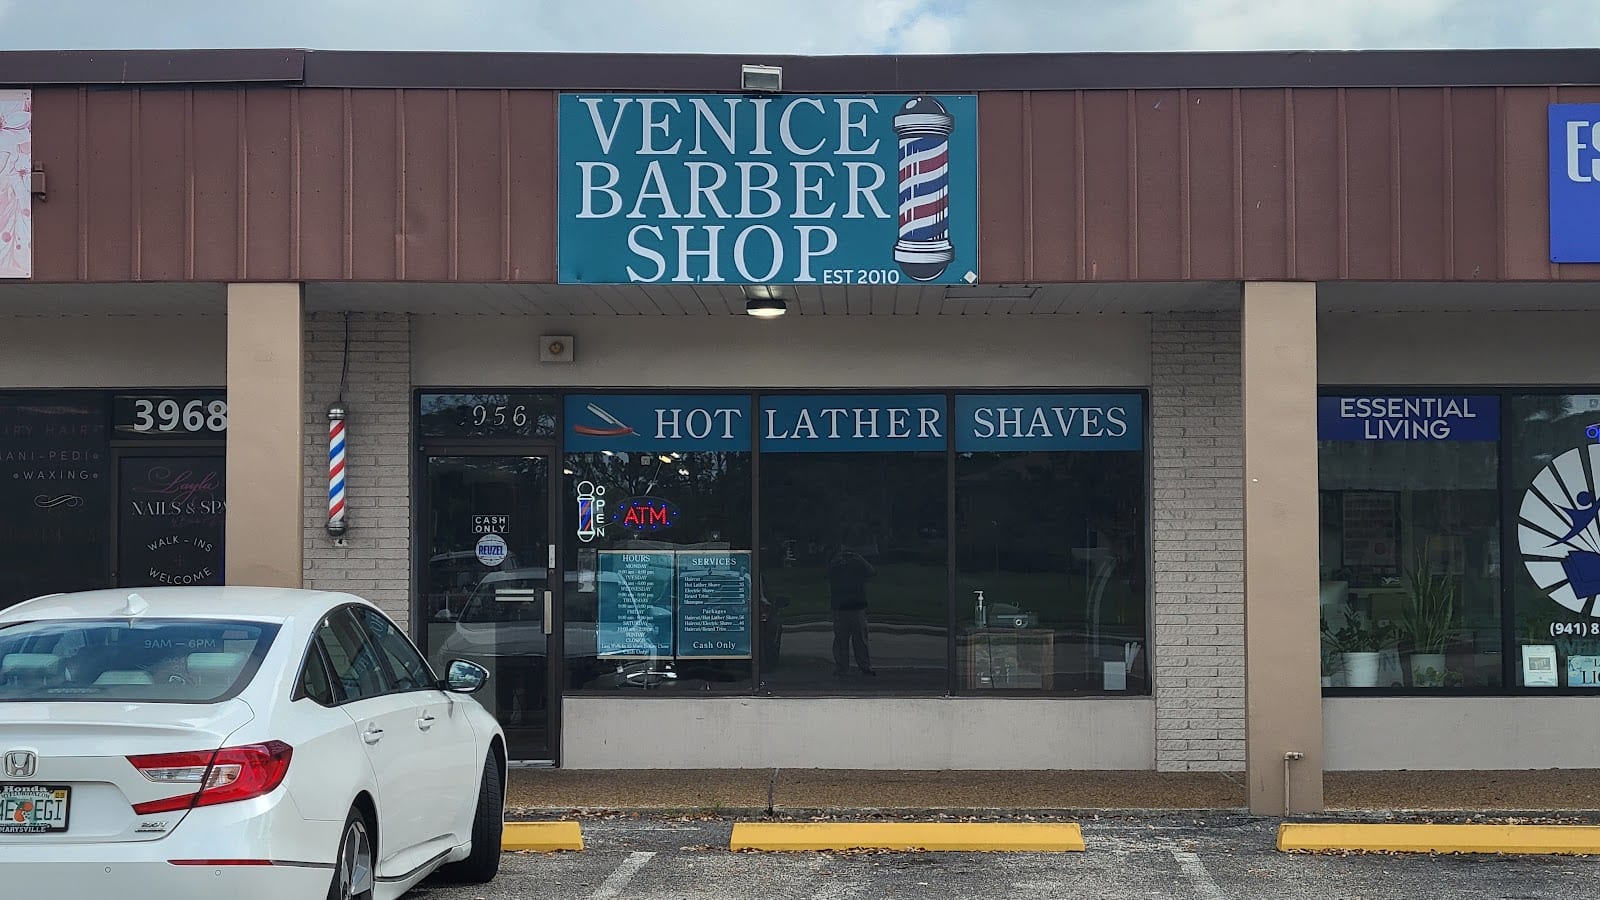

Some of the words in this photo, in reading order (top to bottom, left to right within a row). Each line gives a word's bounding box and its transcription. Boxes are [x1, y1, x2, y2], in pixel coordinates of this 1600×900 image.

[578, 97, 881, 156] VENICE
[575, 160, 891, 219] BARBER
[625, 224, 838, 283] SHOP
[823, 270, 854, 284] EST
[857, 270, 900, 284] 2010
[133, 399, 226, 432] 3968
[1340, 398, 1476, 418] ESSENTIAL
[654, 408, 742, 439] HOT
[764, 408, 943, 439] LATHER
[973, 407, 1127, 438] SHAVES
[1364, 419, 1451, 440] LIVING
[0, 450, 88, 461] ANI-PEDI
[23, 470, 89, 480] WAXING
[131, 500, 181, 516] NAILS
[185, 502, 196, 515] &
[595, 485, 606, 537] OPEN
[624, 505, 668, 525] ATM
[475, 516, 506, 524] CASH
[475, 525, 506, 533] ONLY
[147, 535, 180, 552] WALK
[193, 536, 213, 553] INS
[478, 545, 505, 556] REUZEL
[622, 554, 650, 562] HOURS
[692, 557, 737, 566] SERVICES
[149, 565, 212, 585] WELCOME
[1550, 622, 1587, 637] (941)
[144, 639, 172, 649] 9AM
[188, 639, 216, 649] 6PM
[693, 641, 714, 649] Cash
[716, 641, 736, 650] Only
[1582, 671, 1600, 684] LI
[0, 800, 15, 820] E
[34, 799, 63, 820] EGI
